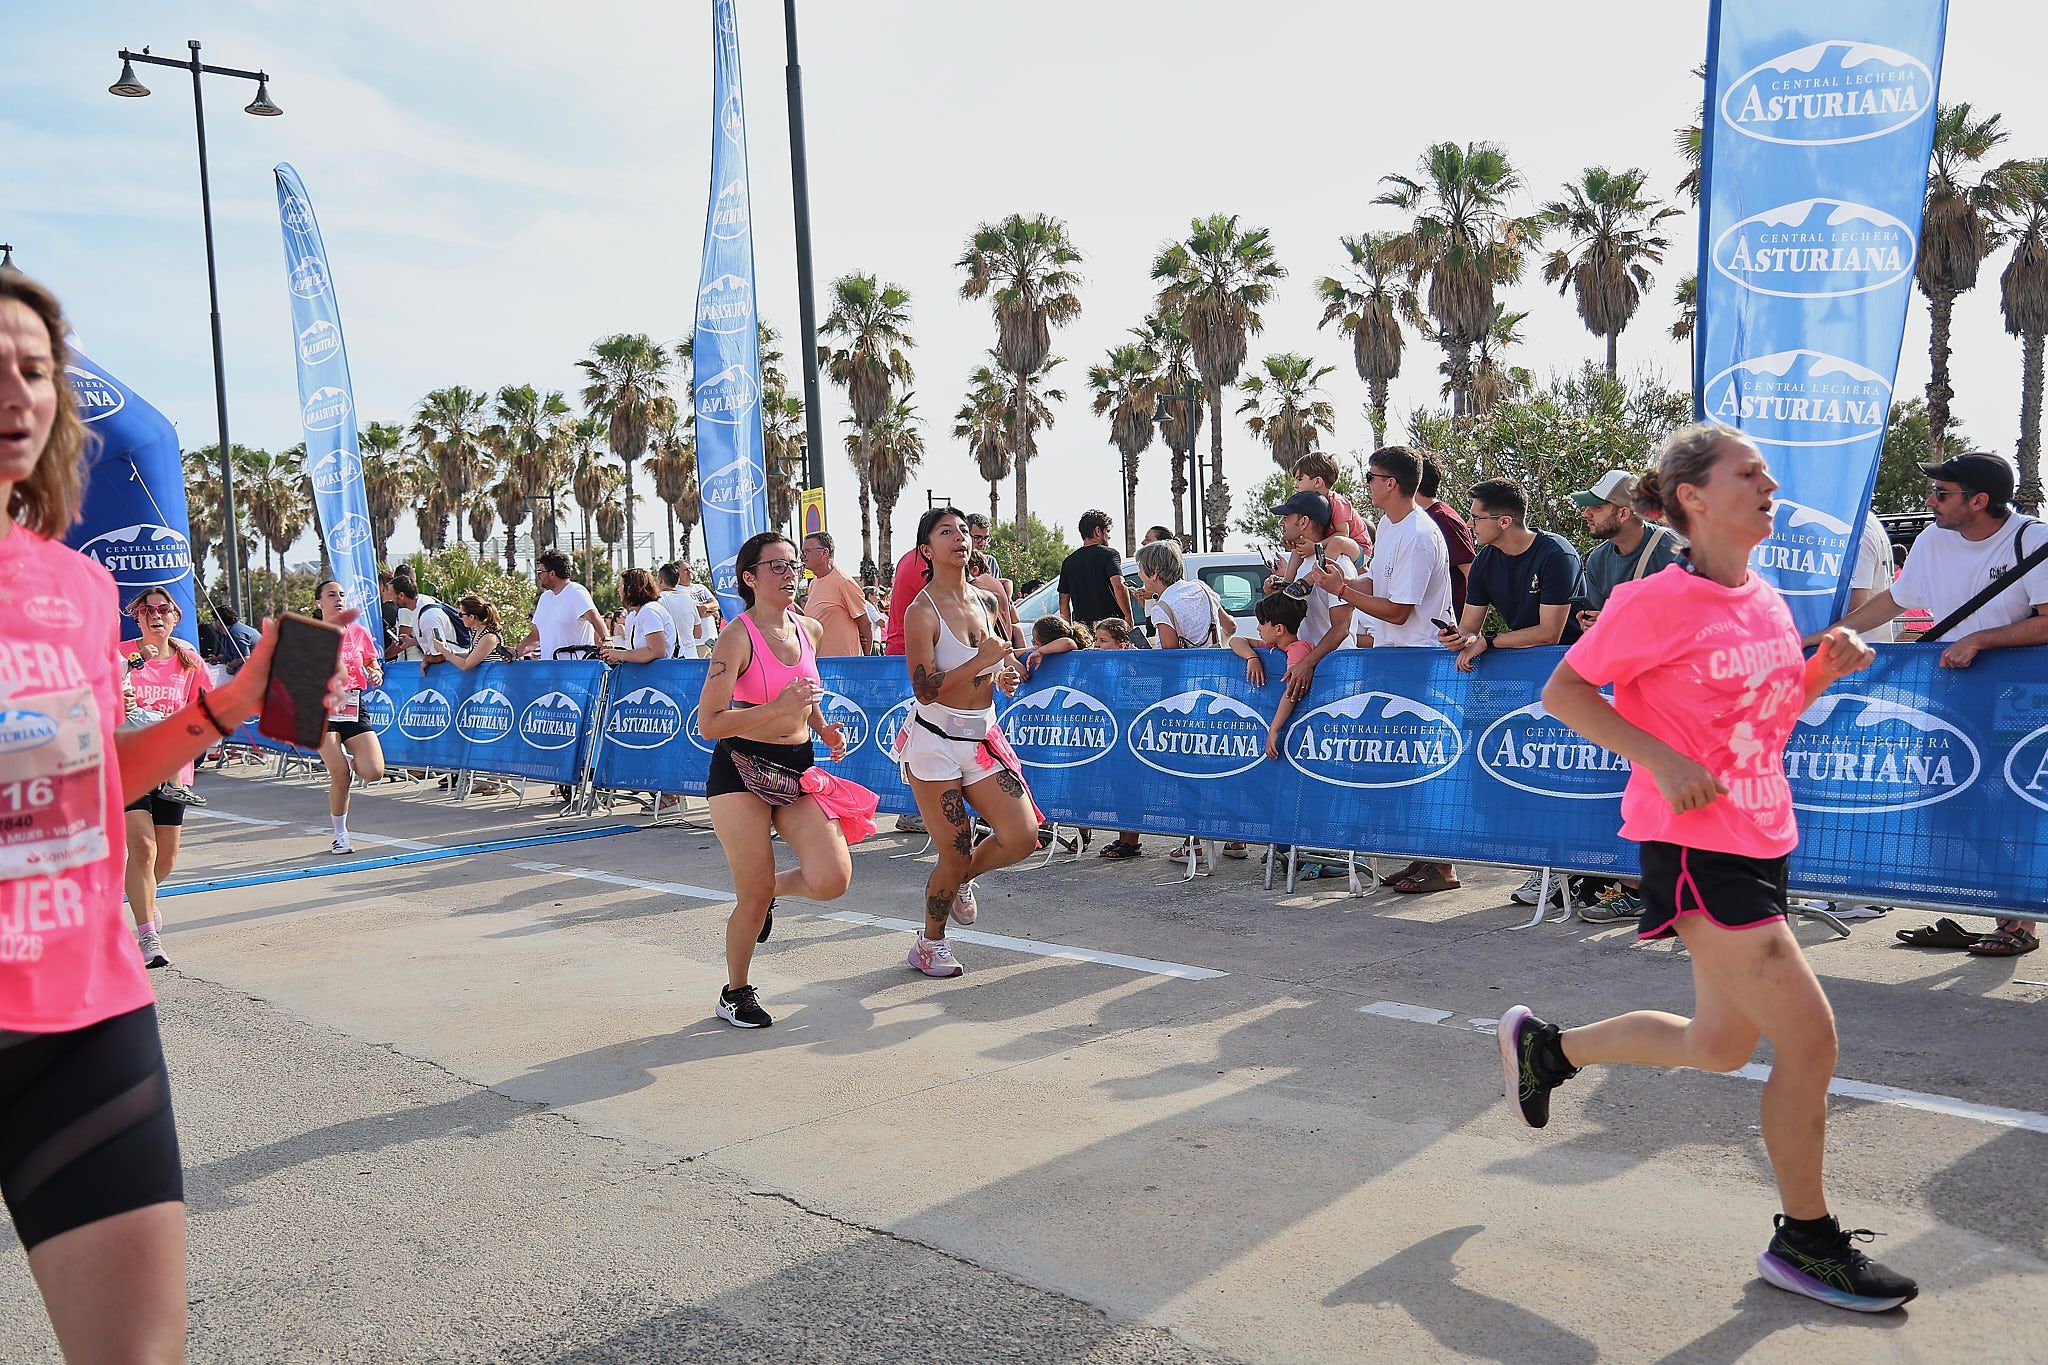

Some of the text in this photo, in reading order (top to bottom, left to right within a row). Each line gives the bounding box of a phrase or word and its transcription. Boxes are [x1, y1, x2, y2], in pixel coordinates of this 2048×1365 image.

[1772, 71, 1915, 91] CENTRAL LECHERA
[1736, 85, 1919, 123] ASTURIANA
[1760, 231, 1900, 244] CENTRAL LECHERA
[1727, 236, 1903, 272] ASTURIANA
[1744, 381, 1880, 396] CENTRAL LECHERA
[1715, 381, 1883, 425] ASTURIANA
[105, 545, 152, 553] CENTRAL
[1792, 534, 1847, 548] LECHER
[1747, 545, 1841, 577] URIAN
[401, 707, 447, 727] ASTURIANA
[459, 708, 508, 730] ASTURIANA
[523, 712, 576, 736] ASTURIANA
[606, 710, 673, 734] ASTURIANA
[1021, 714, 1105, 723] CENTRAL LECHERA
[1161, 719, 1258, 730] CENTRAL LECHERA
[1005, 716, 1106, 747] ASTURIANA
[1137, 719, 1259, 757] ASTURIANA
[1323, 724, 1443, 735] CENTRAL LECHERA
[1526, 727, 1581, 738] CENTR
[1294, 725, 1447, 765] ASTURIANA
[1491, 729, 1632, 772] ASTURIA
[1786, 734, 1950, 748] ENTRAL LECHERA
[1784, 750, 1956, 786] TURIANA
